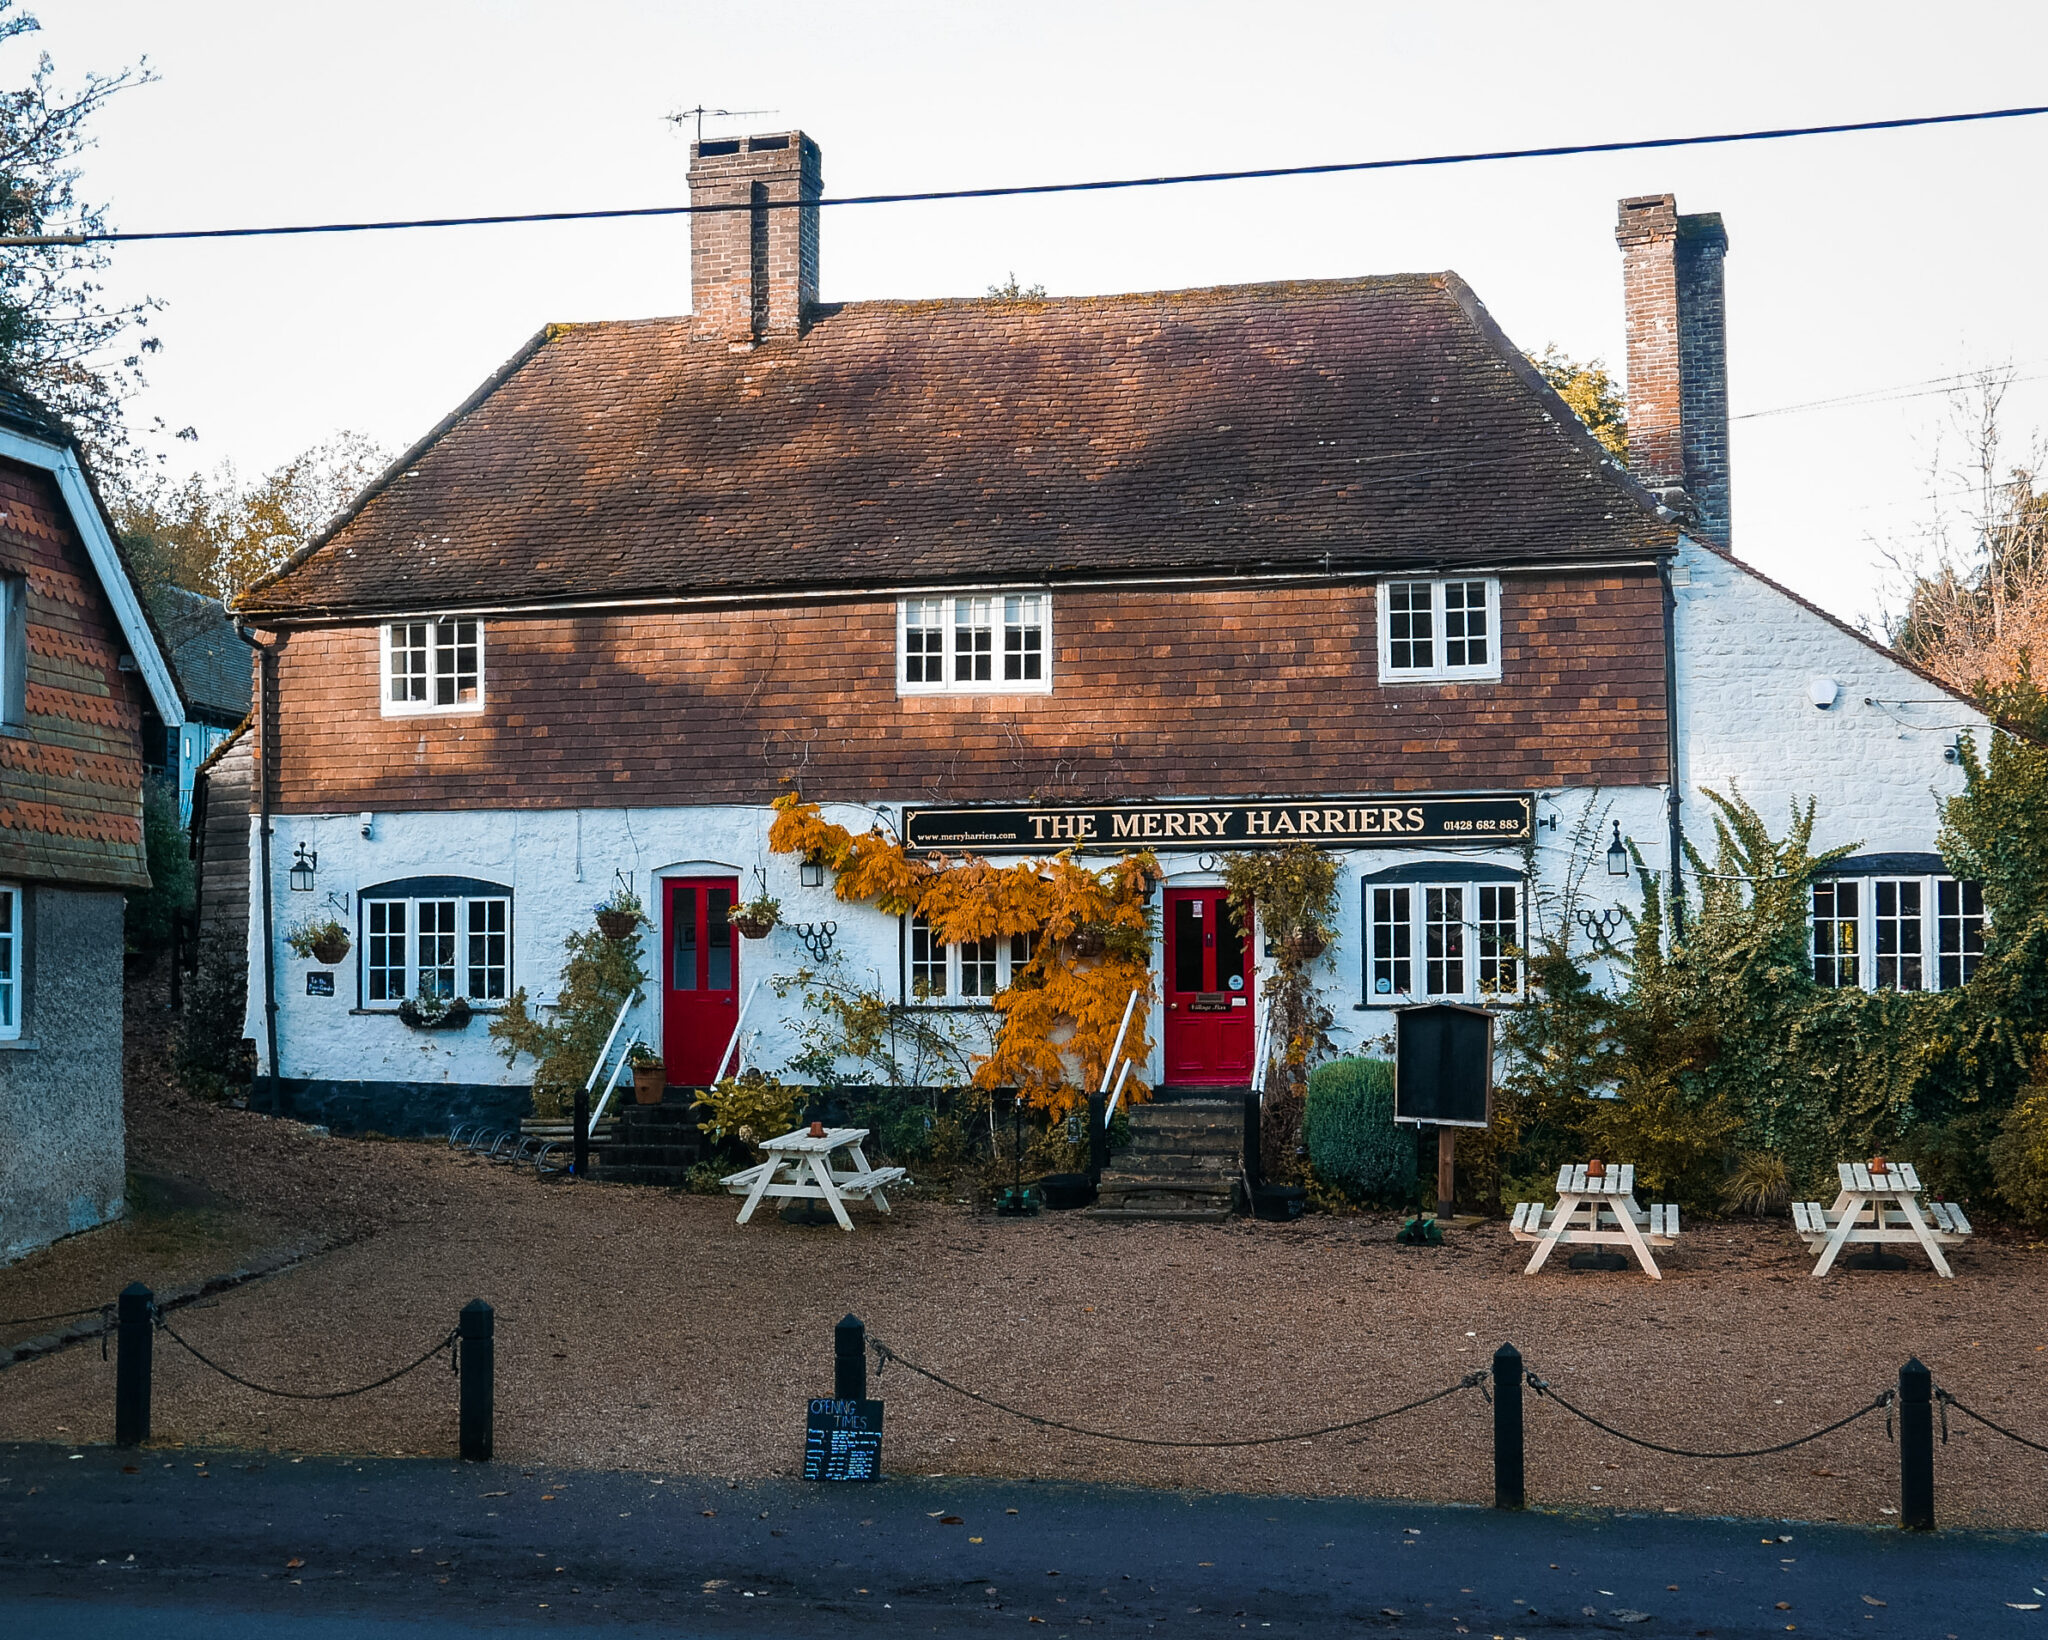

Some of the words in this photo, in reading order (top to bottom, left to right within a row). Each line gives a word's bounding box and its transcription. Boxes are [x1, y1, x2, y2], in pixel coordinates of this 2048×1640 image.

[1028, 814, 1098, 839] THE
[1111, 811, 1233, 838] MERRY
[1246, 807, 1425, 835] HARRIERS
[1443, 820, 1473, 831] 01428
[1476, 819, 1496, 830] 682
[1499, 819, 1519, 830] 883
[917, 831, 1017, 842] www.merryharriers.com
[810, 1400, 856, 1415] OPENING
[833, 1415, 867, 1429] TIMES
